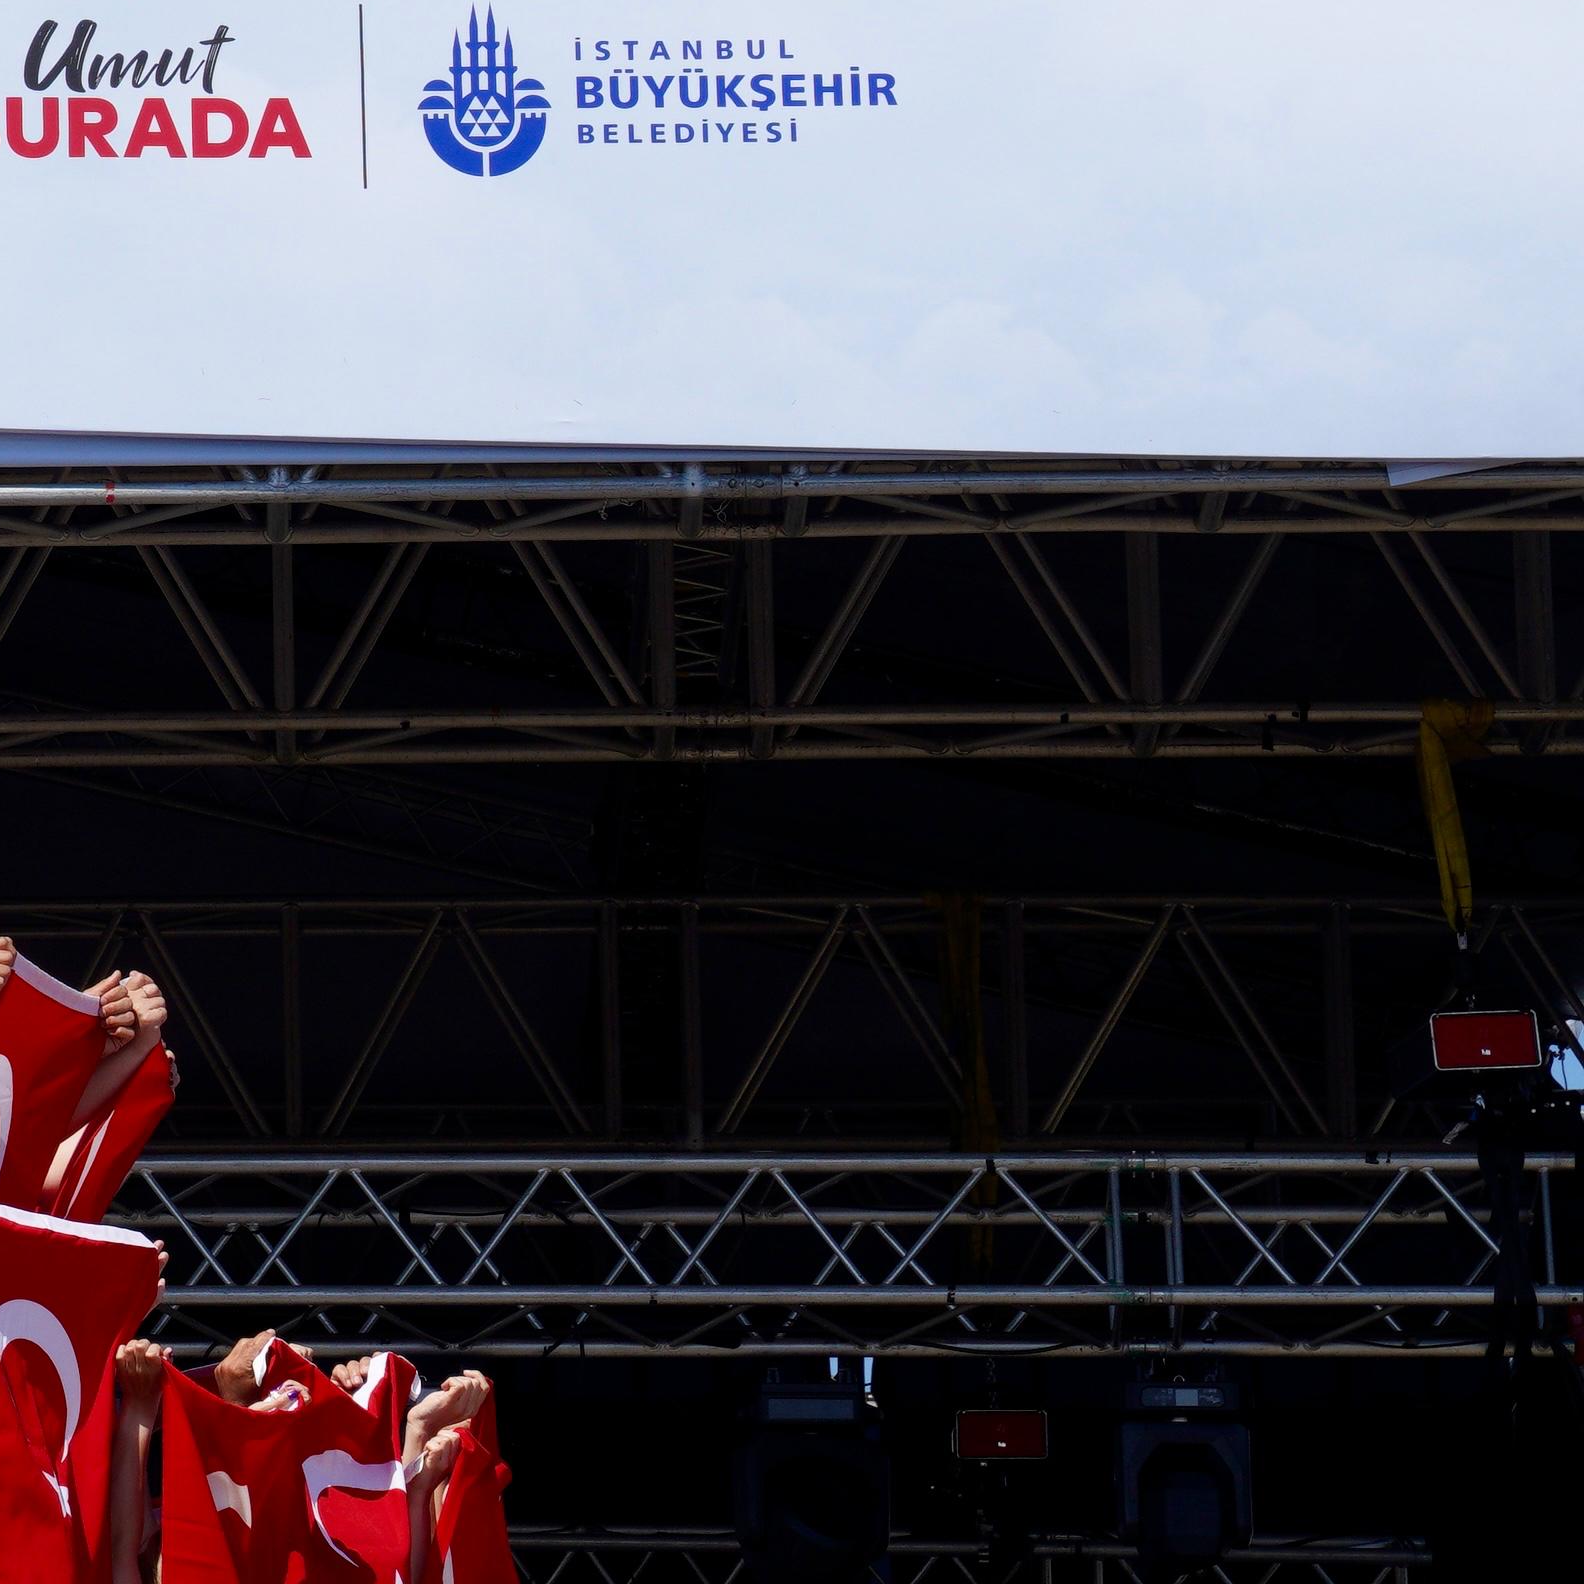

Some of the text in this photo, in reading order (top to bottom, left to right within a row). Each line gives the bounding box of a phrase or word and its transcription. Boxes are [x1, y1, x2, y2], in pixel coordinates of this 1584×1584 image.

[23, 18, 236, 95] Umut
[574, 36, 795, 62] İSTANBUL
[575, 66, 899, 112] BÜYÜKŞEHİR
[577, 118, 799, 145] BELEDİYESİ
